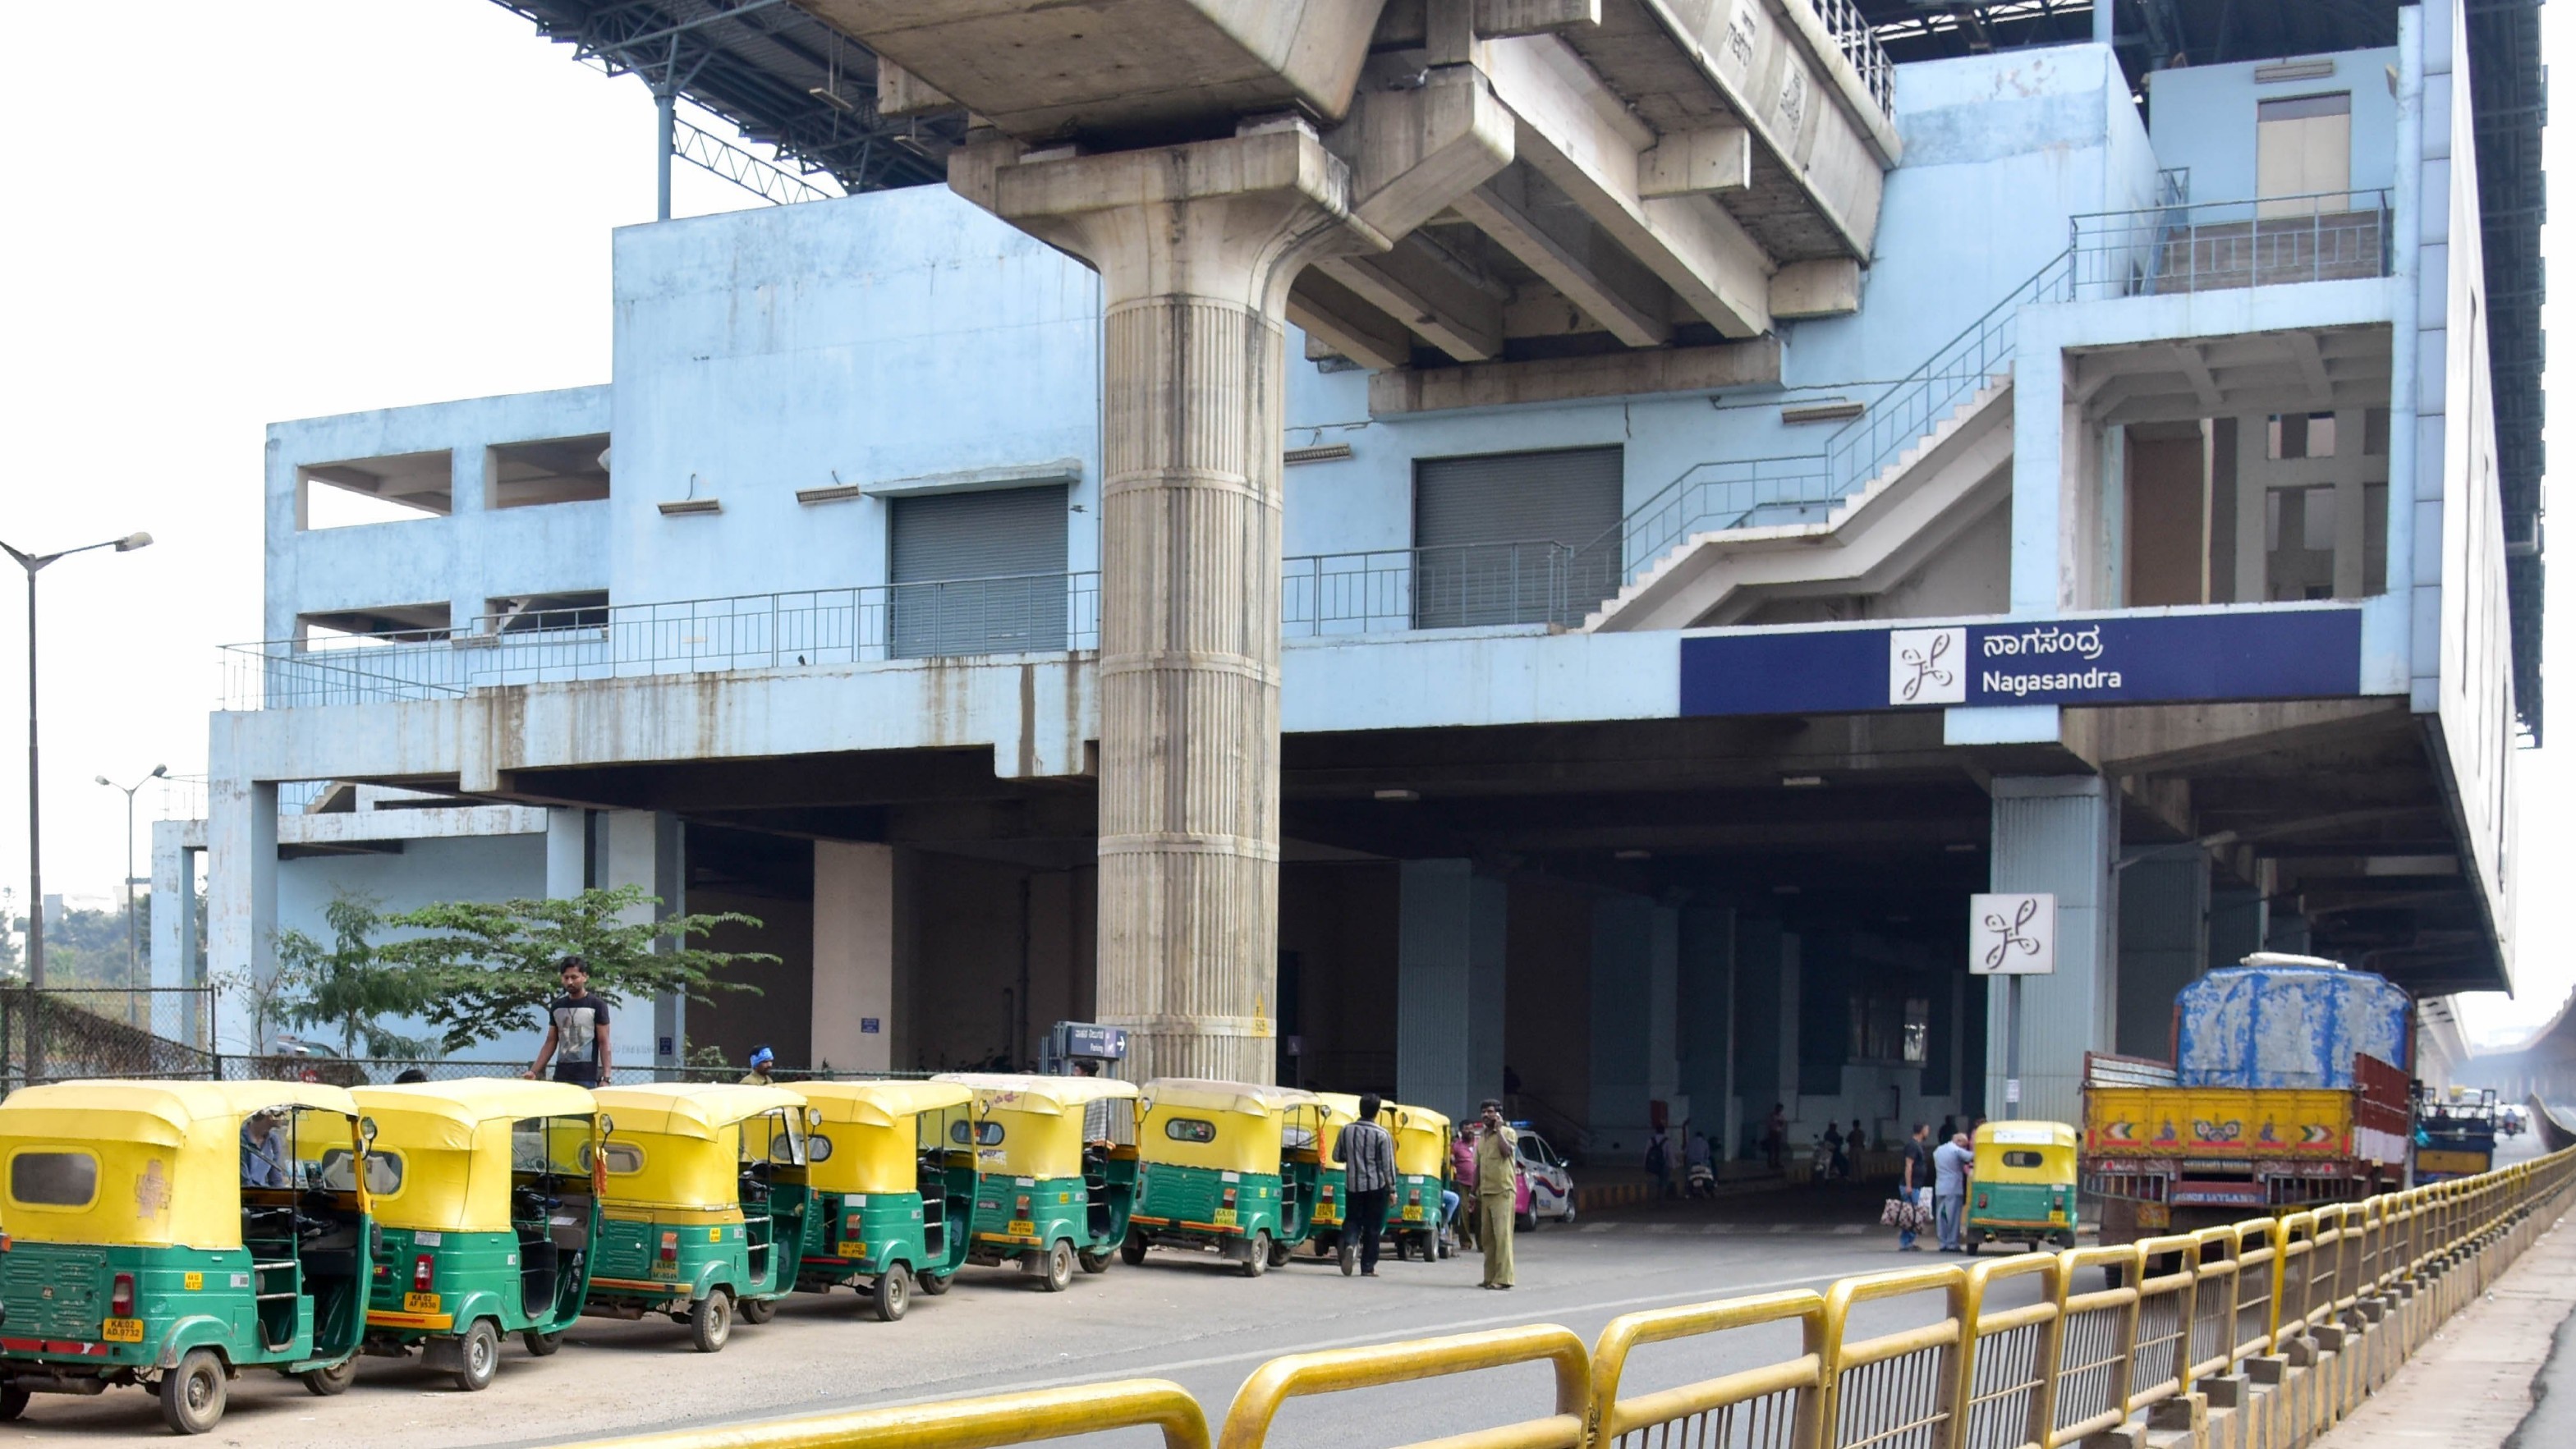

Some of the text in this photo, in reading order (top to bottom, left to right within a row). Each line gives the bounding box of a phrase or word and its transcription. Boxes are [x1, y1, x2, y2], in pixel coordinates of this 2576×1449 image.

[1983, 624, 2104, 659] ನಾಗಸಂದ್ರ
[1982, 667, 2122, 697] Nagasandra
[1090, 1043, 1103, 1054] Parking
[423, 1293, 432, 1301] 02
